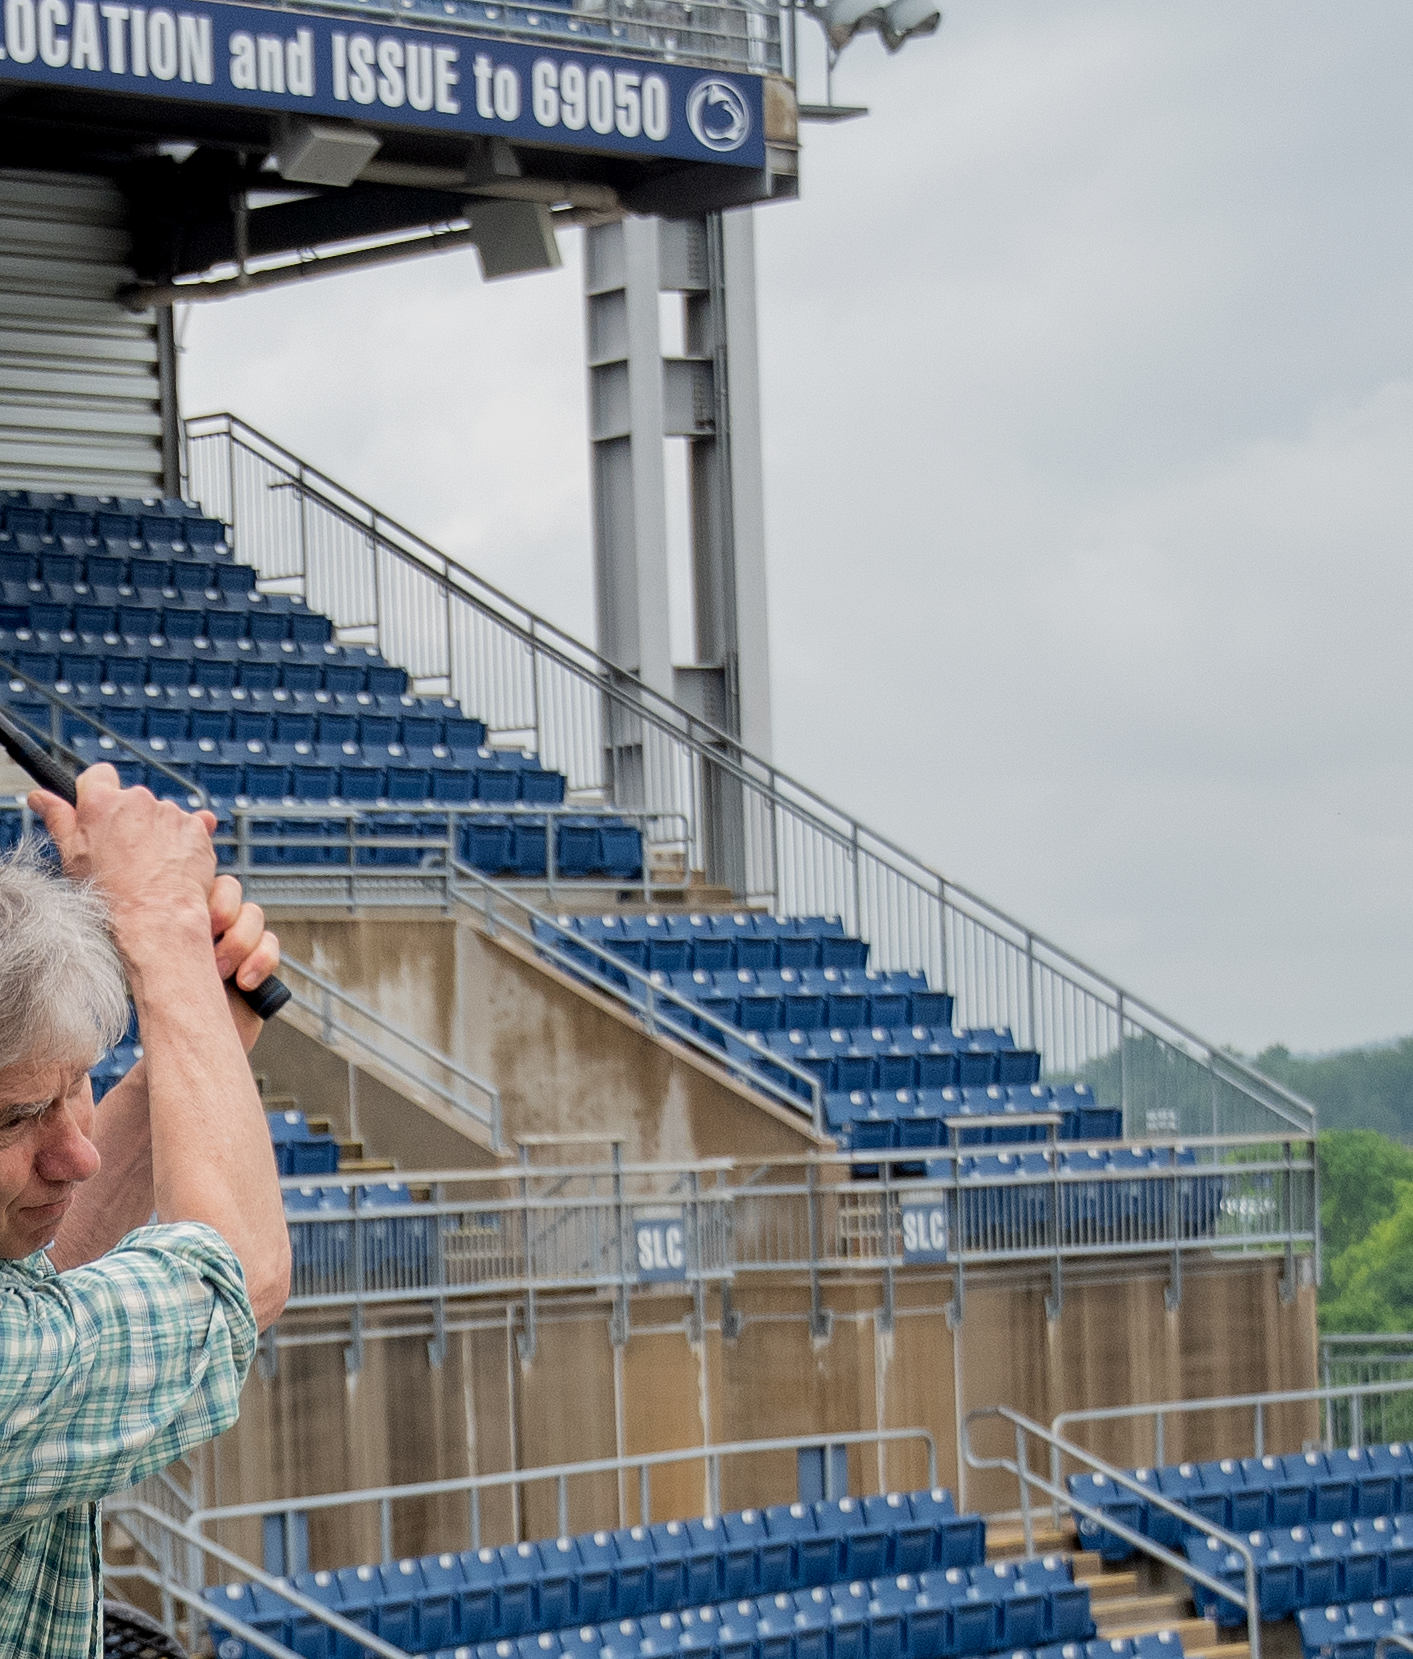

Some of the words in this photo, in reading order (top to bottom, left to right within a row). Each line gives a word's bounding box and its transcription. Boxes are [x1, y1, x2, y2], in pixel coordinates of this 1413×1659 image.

[228, 27, 315, 97] and
[330, 31, 461, 115] ISSUE
[472, 54, 521, 122] to
[531, 59, 671, 142] 69050
[637, 1226, 683, 1271] SLC
[901, 1210, 944, 1252] SLC
